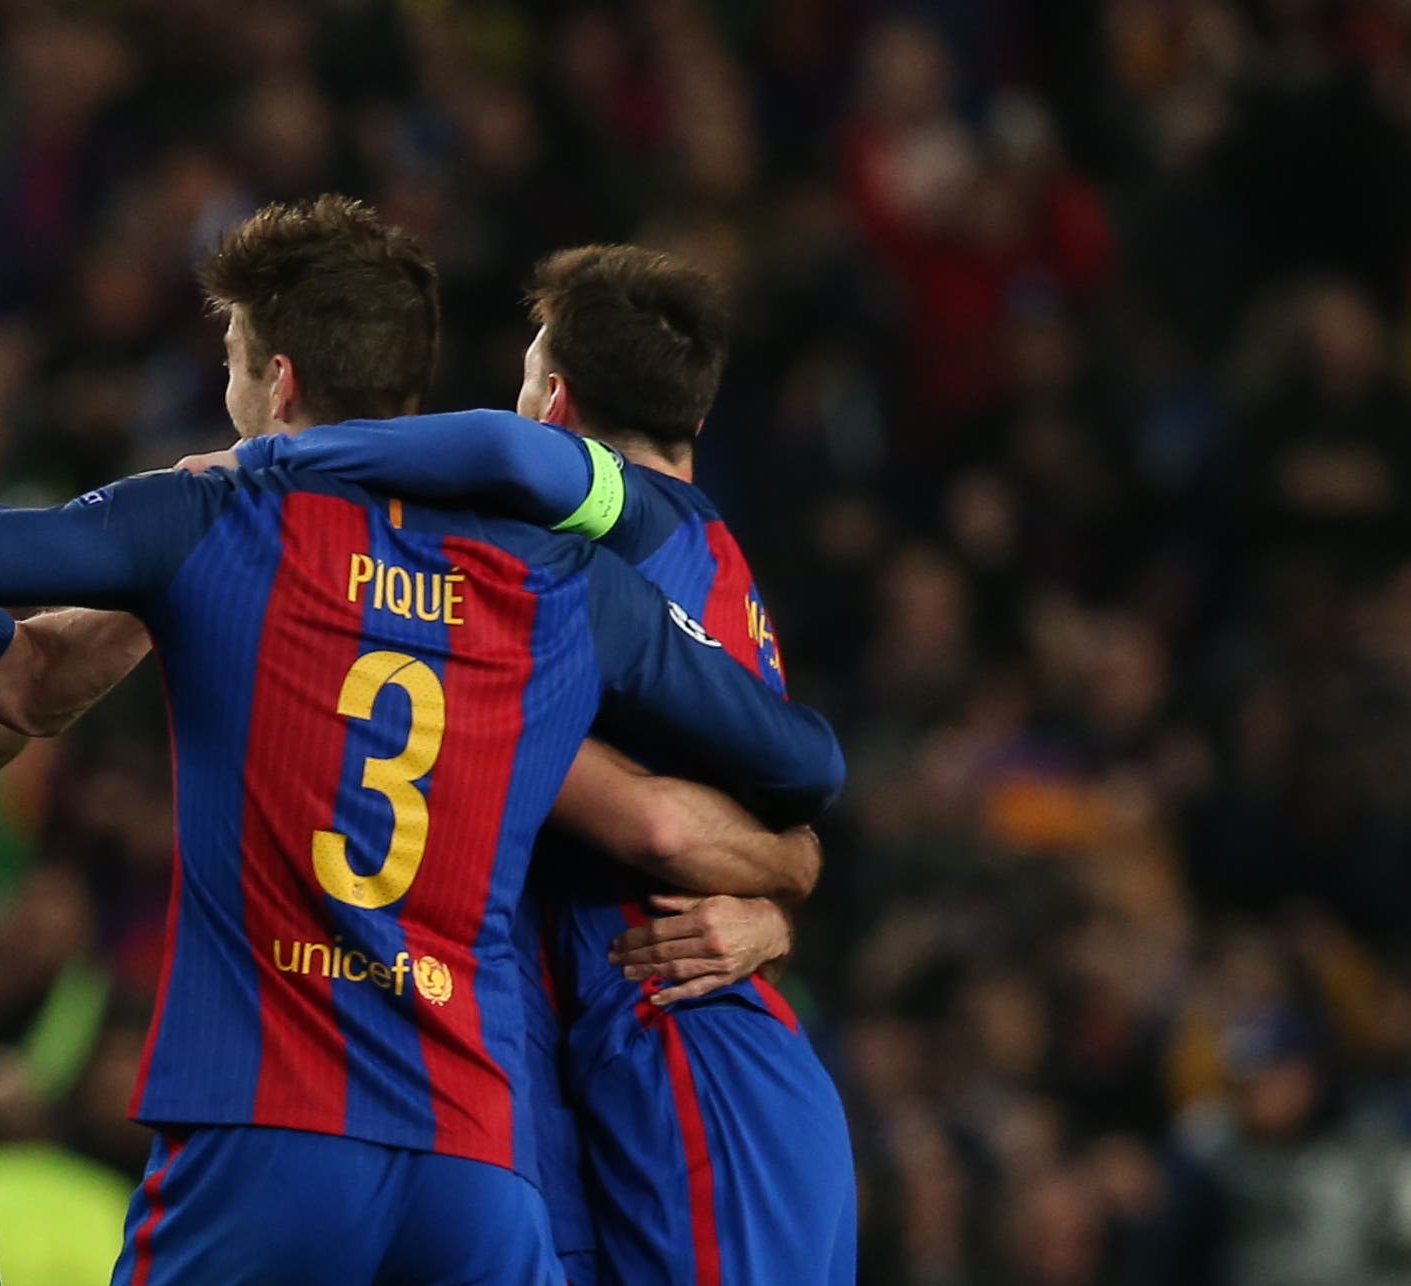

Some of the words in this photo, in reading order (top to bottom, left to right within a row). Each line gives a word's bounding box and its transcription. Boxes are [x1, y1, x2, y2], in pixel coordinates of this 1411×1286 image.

[347, 553, 466, 625] PIQUÉ
[311, 649, 446, 910] 3
[273, 934, 411, 996] unicef
